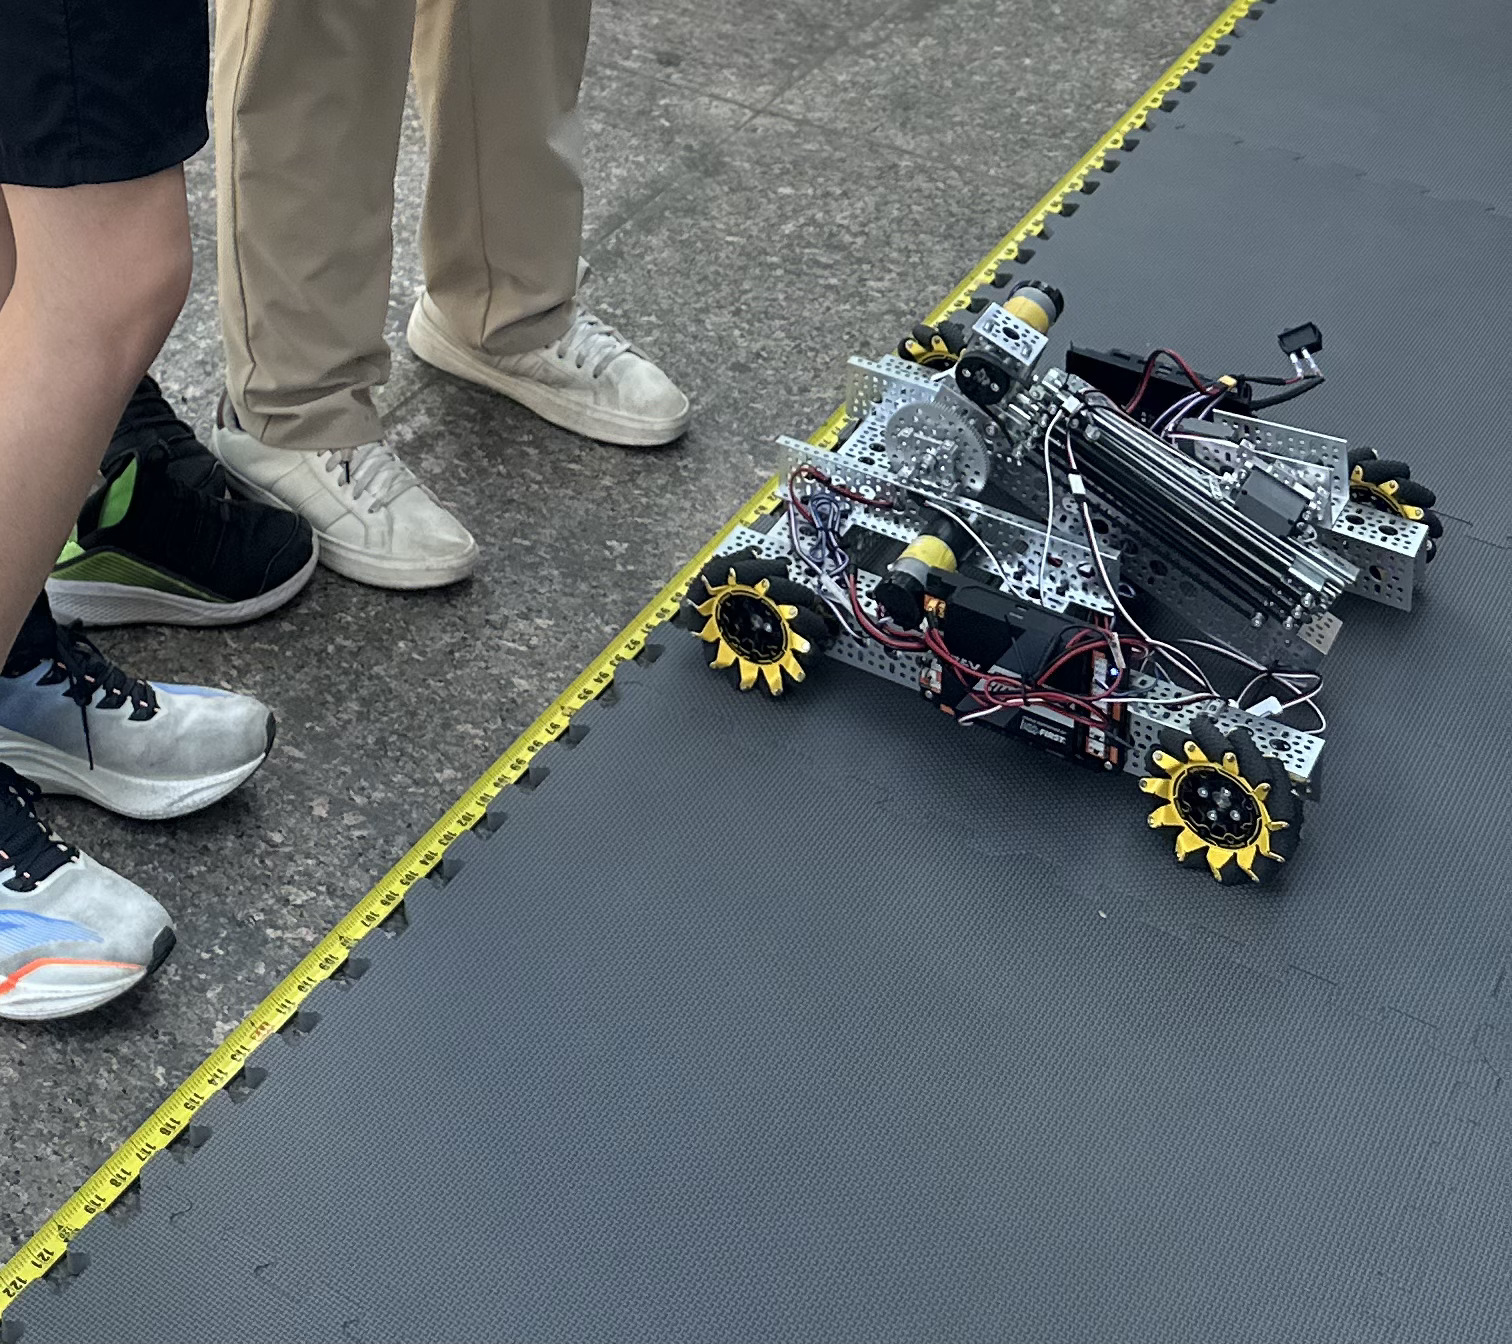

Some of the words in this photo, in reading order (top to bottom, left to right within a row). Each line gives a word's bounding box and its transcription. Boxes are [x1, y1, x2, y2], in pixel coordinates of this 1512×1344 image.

[624, 638, 641, 651] 92
[593, 671, 610, 684] 94
[577, 688, 594, 701] 95
[544, 721, 561, 736] 97
[527, 739, 544, 753] 98
[510, 757, 527, 771] 99
[475, 792, 495, 807] 101
[456, 811, 475, 827] 102
[437, 830, 457, 847] 103
[419, 850, 439, 866] 104
[399, 870, 419, 887] 105
[380, 890, 400, 907] 106
[360, 910, 380, 928] 107
[318, 953, 339, 971] 109
[297, 976, 317, 993] 110
[275, 998, 296, 1015] 111
[230, 1044, 250, 1062] 113
[207, 1067, 228, 1087] 114
[183, 1092, 205, 1111] 115
[159, 1117, 181, 1137] 116
[135, 1142, 157, 1162] 117
[109, 1167, 132, 1188] 118
[83, 1194, 107, 1215] 119
[30, 1247, 55, 1269] 121
[2, 1275, 28, 1299] 122
